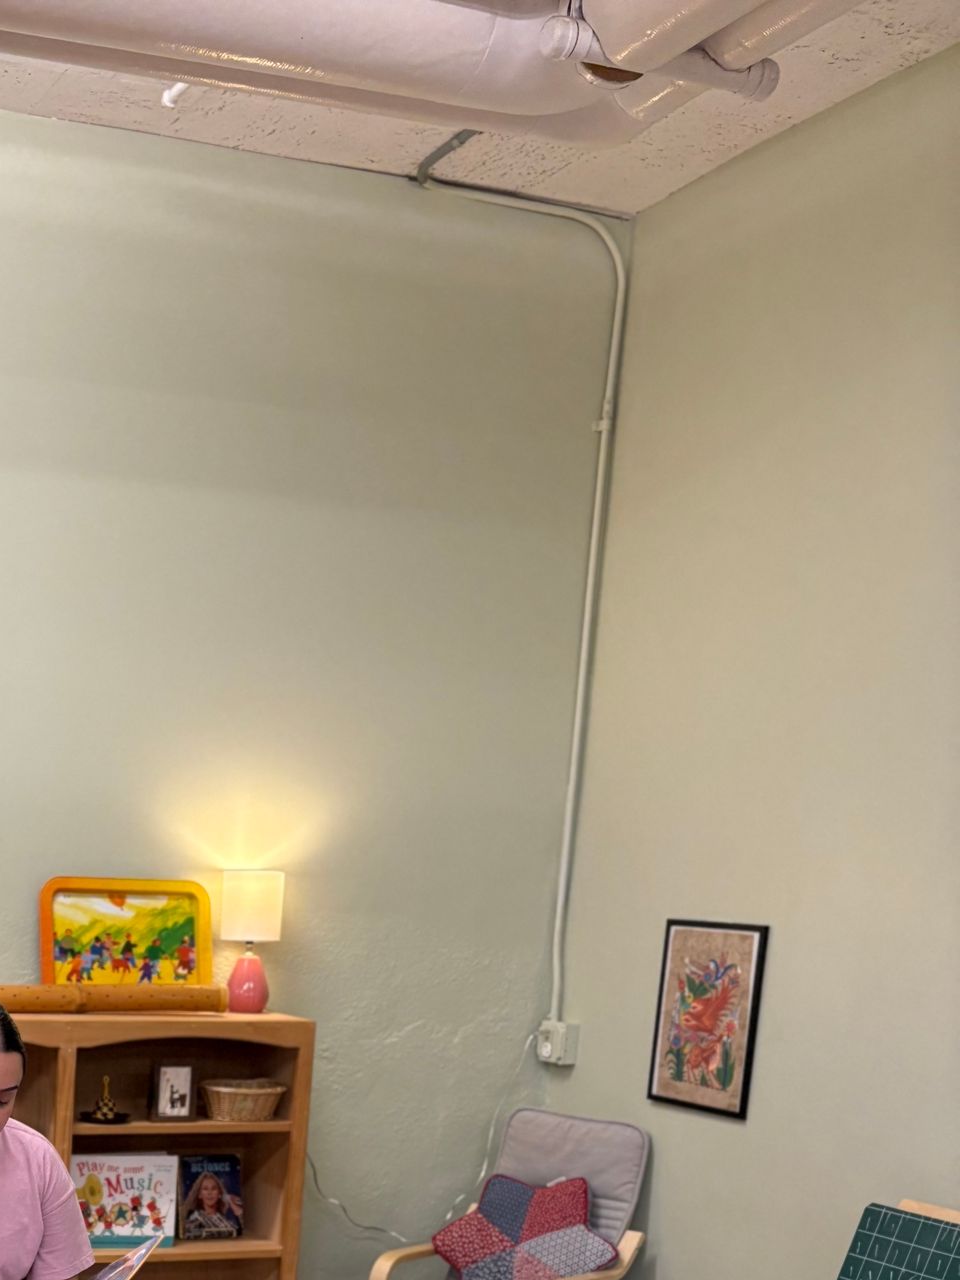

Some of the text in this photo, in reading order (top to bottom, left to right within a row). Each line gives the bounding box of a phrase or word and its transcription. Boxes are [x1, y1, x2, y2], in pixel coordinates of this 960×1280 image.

[76, 1161, 105, 1177] Play
[107, 1165, 120, 1173] me
[104, 1172, 164, 1198] Music
